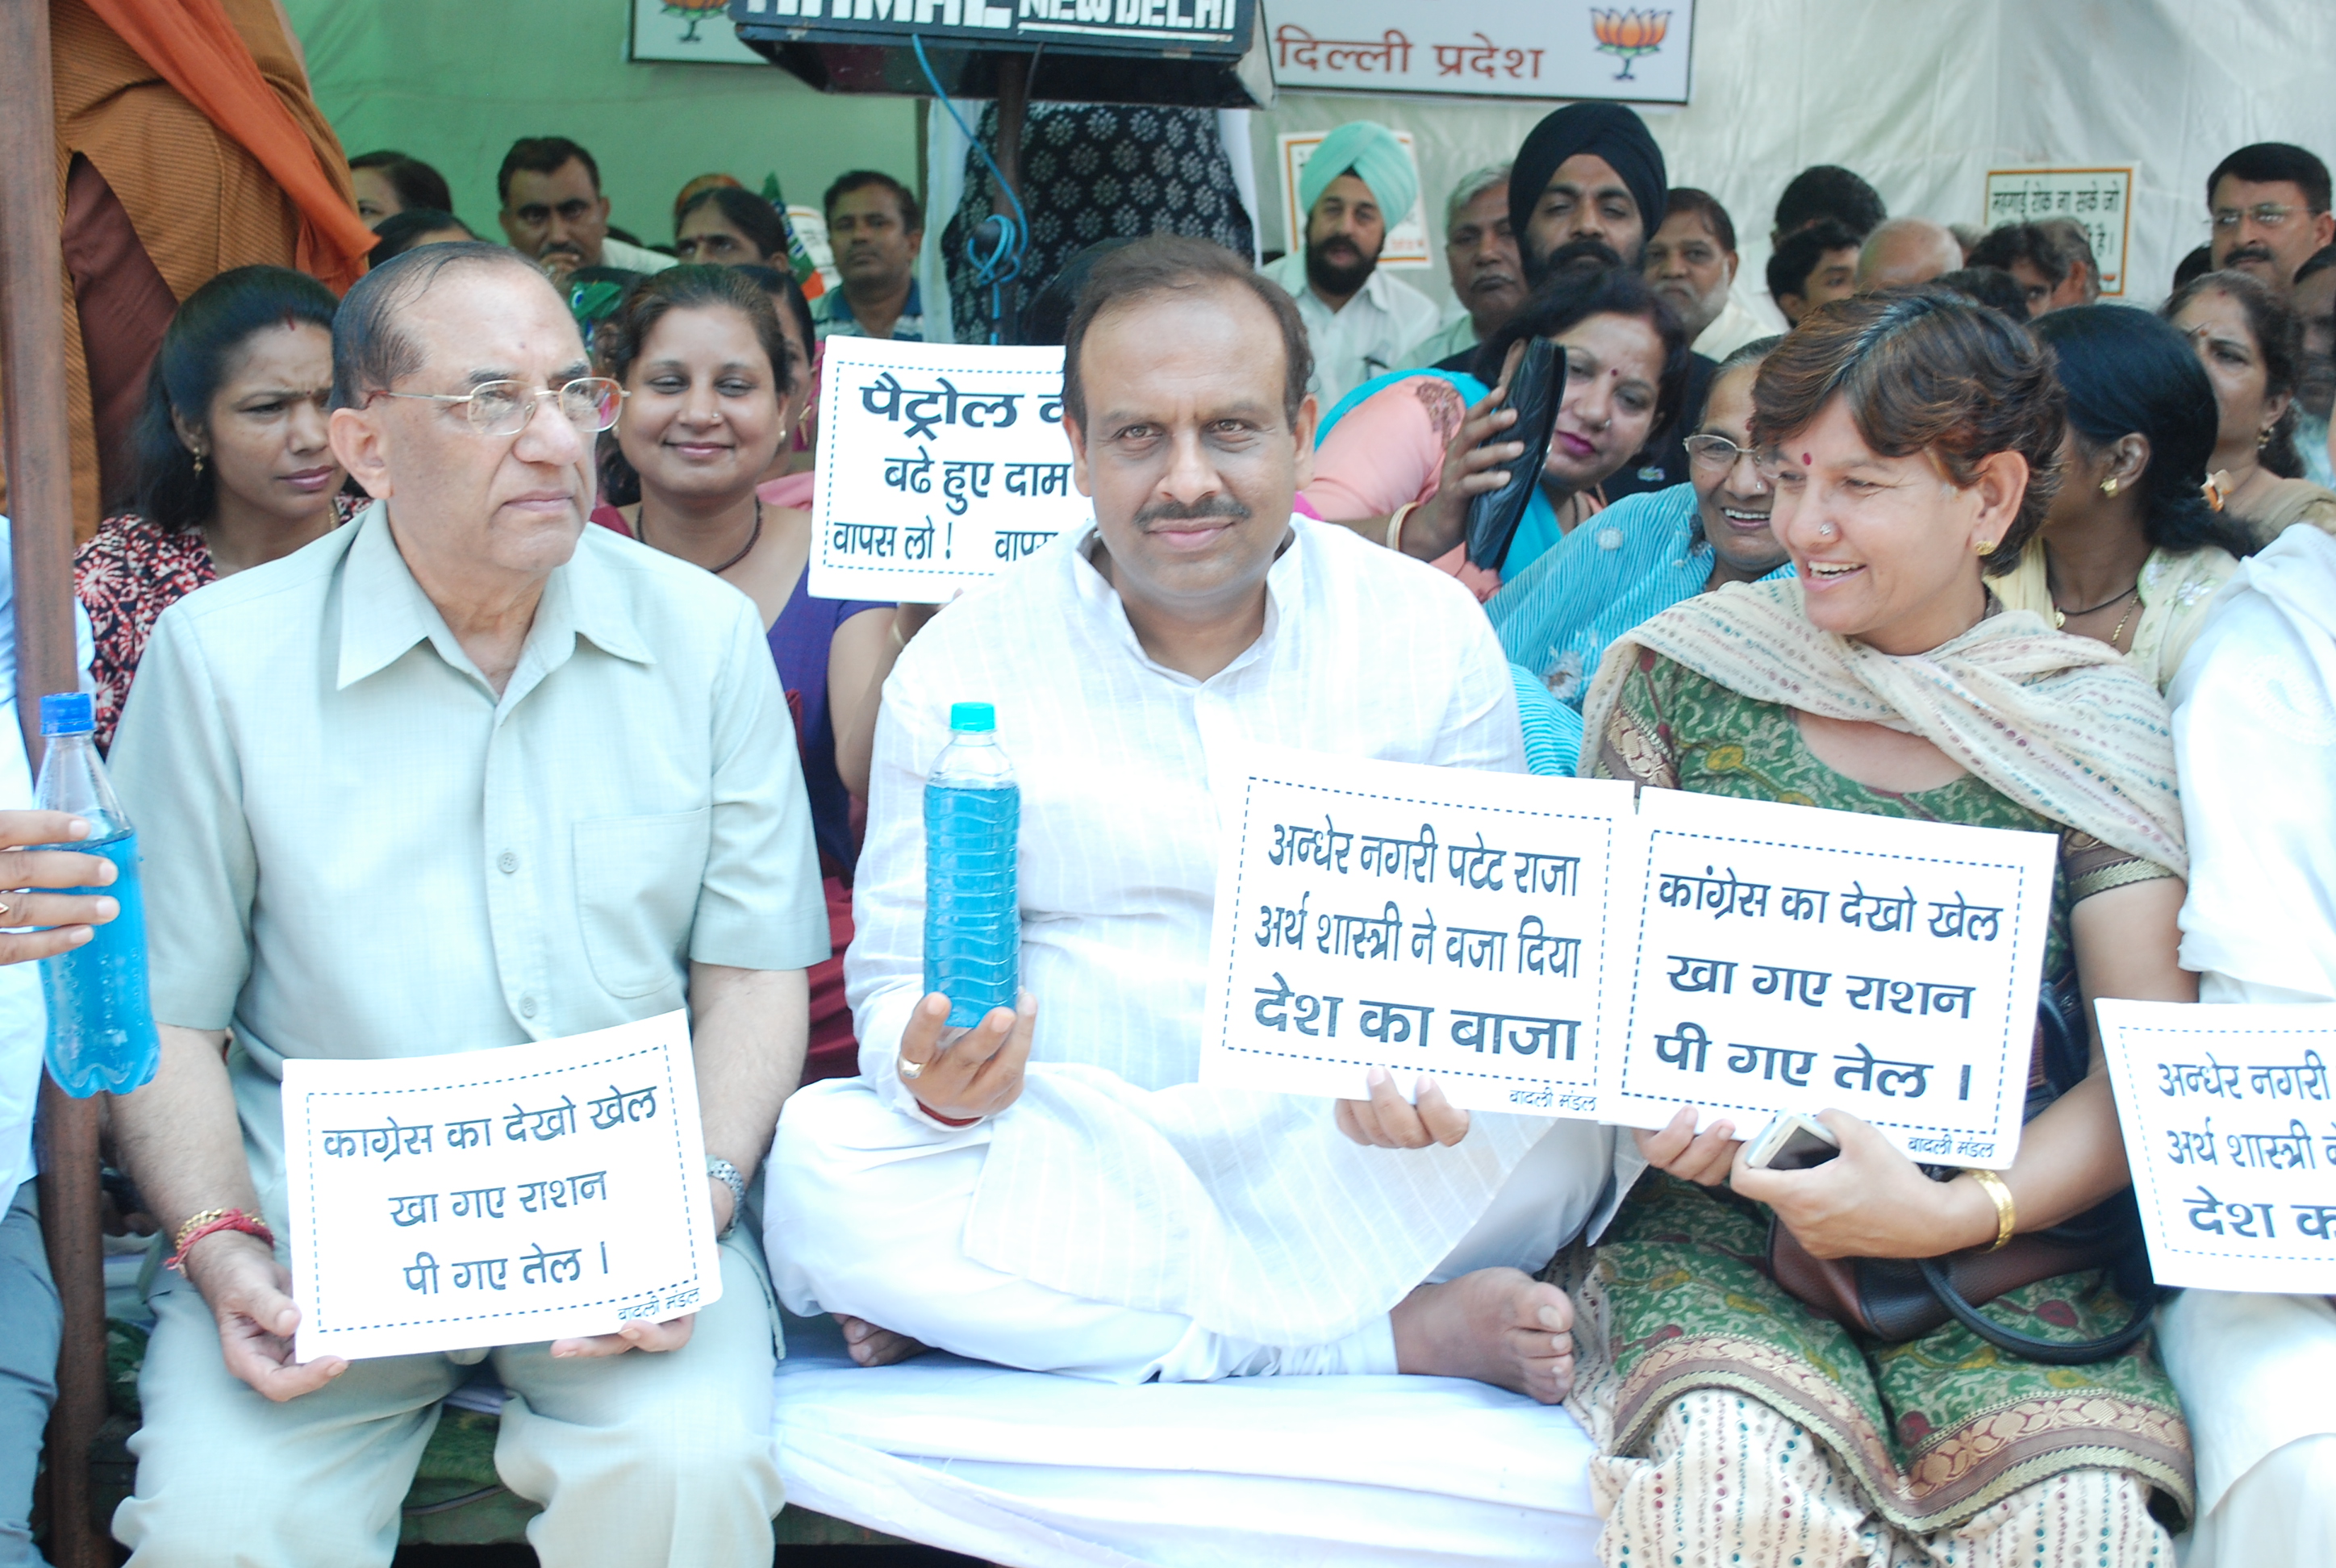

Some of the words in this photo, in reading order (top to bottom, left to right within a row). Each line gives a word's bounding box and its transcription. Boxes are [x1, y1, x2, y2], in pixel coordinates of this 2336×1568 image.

[1115, 0, 1235, 30] DELHI
[1275, 25, 1412, 73] दिल्ली
[1433, 32, 1545, 79] प्रदेश
[858, 369, 1025, 441] पैट्रोल
[942, 461, 995, 516] हुए
[1004, 463, 1072, 497] दाम
[833, 521, 898, 557] वापस
[904, 515, 936, 560] लो
[1268, 814, 1354, 874] अन्धेर
[1360, 823, 1439, 883] नगरी
[1514, 852, 1581, 897] राजा
[1659, 865, 1772, 920] कांग्रेस
[1781, 886, 1830, 924] का
[1840, 880, 1918, 932] देखो
[1927, 890, 2004, 942] खेल
[1254, 890, 1310, 951] अर्थ
[1316, 900, 1404, 961] शास्त्री
[1411, 907, 1437, 965] ने
[1517, 915, 1582, 978] दिया
[1666, 955, 1739, 995] खा
[1752, 965, 1833, 1007] गए
[1846, 974, 1977, 1020] राशन
[1254, 971, 1344, 1038] देश
[1358, 999, 1435, 1048] का
[1450, 1009, 1582, 1061] बाजा
[1654, 1021, 1713, 1073] पी
[1728, 1043, 1818, 1087] गए
[1833, 1042, 1934, 1099] तेल
[2158, 1052, 2242, 1099] अन्धेर
[2247, 1049, 2330, 1101] नगरी
[444, 1118, 492, 1149] का
[503, 1095, 577, 1142] देखो
[586, 1084, 657, 1130] खेल
[1558, 1089, 1597, 1111] मंडल
[1956, 1136, 1996, 1158] मंडल
[2167, 1116, 2218, 1166] अर्थ
[2227, 1119, 2316, 1170] शास्त्री
[388, 1194, 439, 1228] खा
[449, 1186, 506, 1219] गए
[517, 1170, 607, 1213] राशन
[2183, 1185, 2276, 1238] देश
[403, 1251, 440, 1295] पी
[451, 1258, 508, 1291] गए
[519, 1242, 582, 1284] तेल
